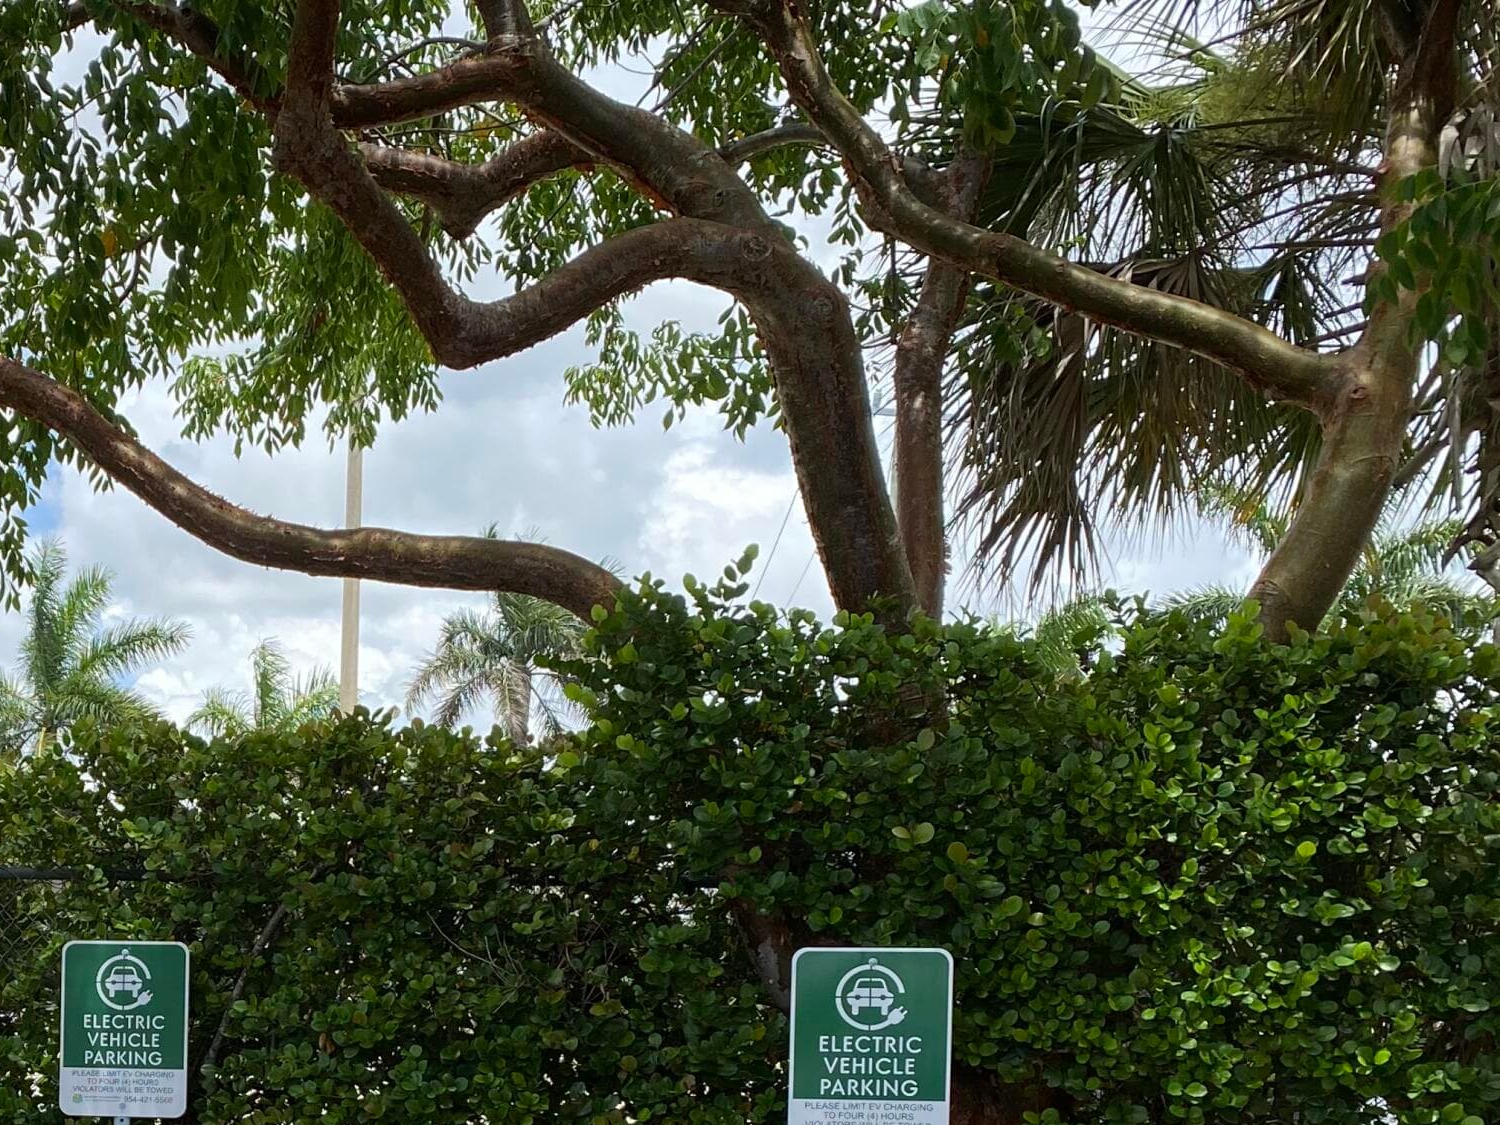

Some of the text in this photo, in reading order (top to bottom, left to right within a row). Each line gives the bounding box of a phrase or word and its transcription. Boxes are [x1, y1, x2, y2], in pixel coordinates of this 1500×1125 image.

[83, 1014, 165, 1030] ELECTRIC
[87, 1031, 160, 1048] VEHICLE
[819, 1035, 922, 1054] ELECTRIC
[84, 1050, 162, 1066] PARKING
[823, 1057, 916, 1075] VEHICLE
[72, 1085, 114, 1093] VIOLATORS
[134, 1086, 145, 1094] BE
[819, 1078, 919, 1097] PARKING
[804, 1102, 840, 1110] PLEASE
[868, 1103, 881, 1111] EV
[884, 1103, 934, 1112] CHARGING
[838, 1112, 865, 1120] FOUR
[867, 1112, 879, 1121] (4)
[881, 1113, 914, 1121] HOURS
